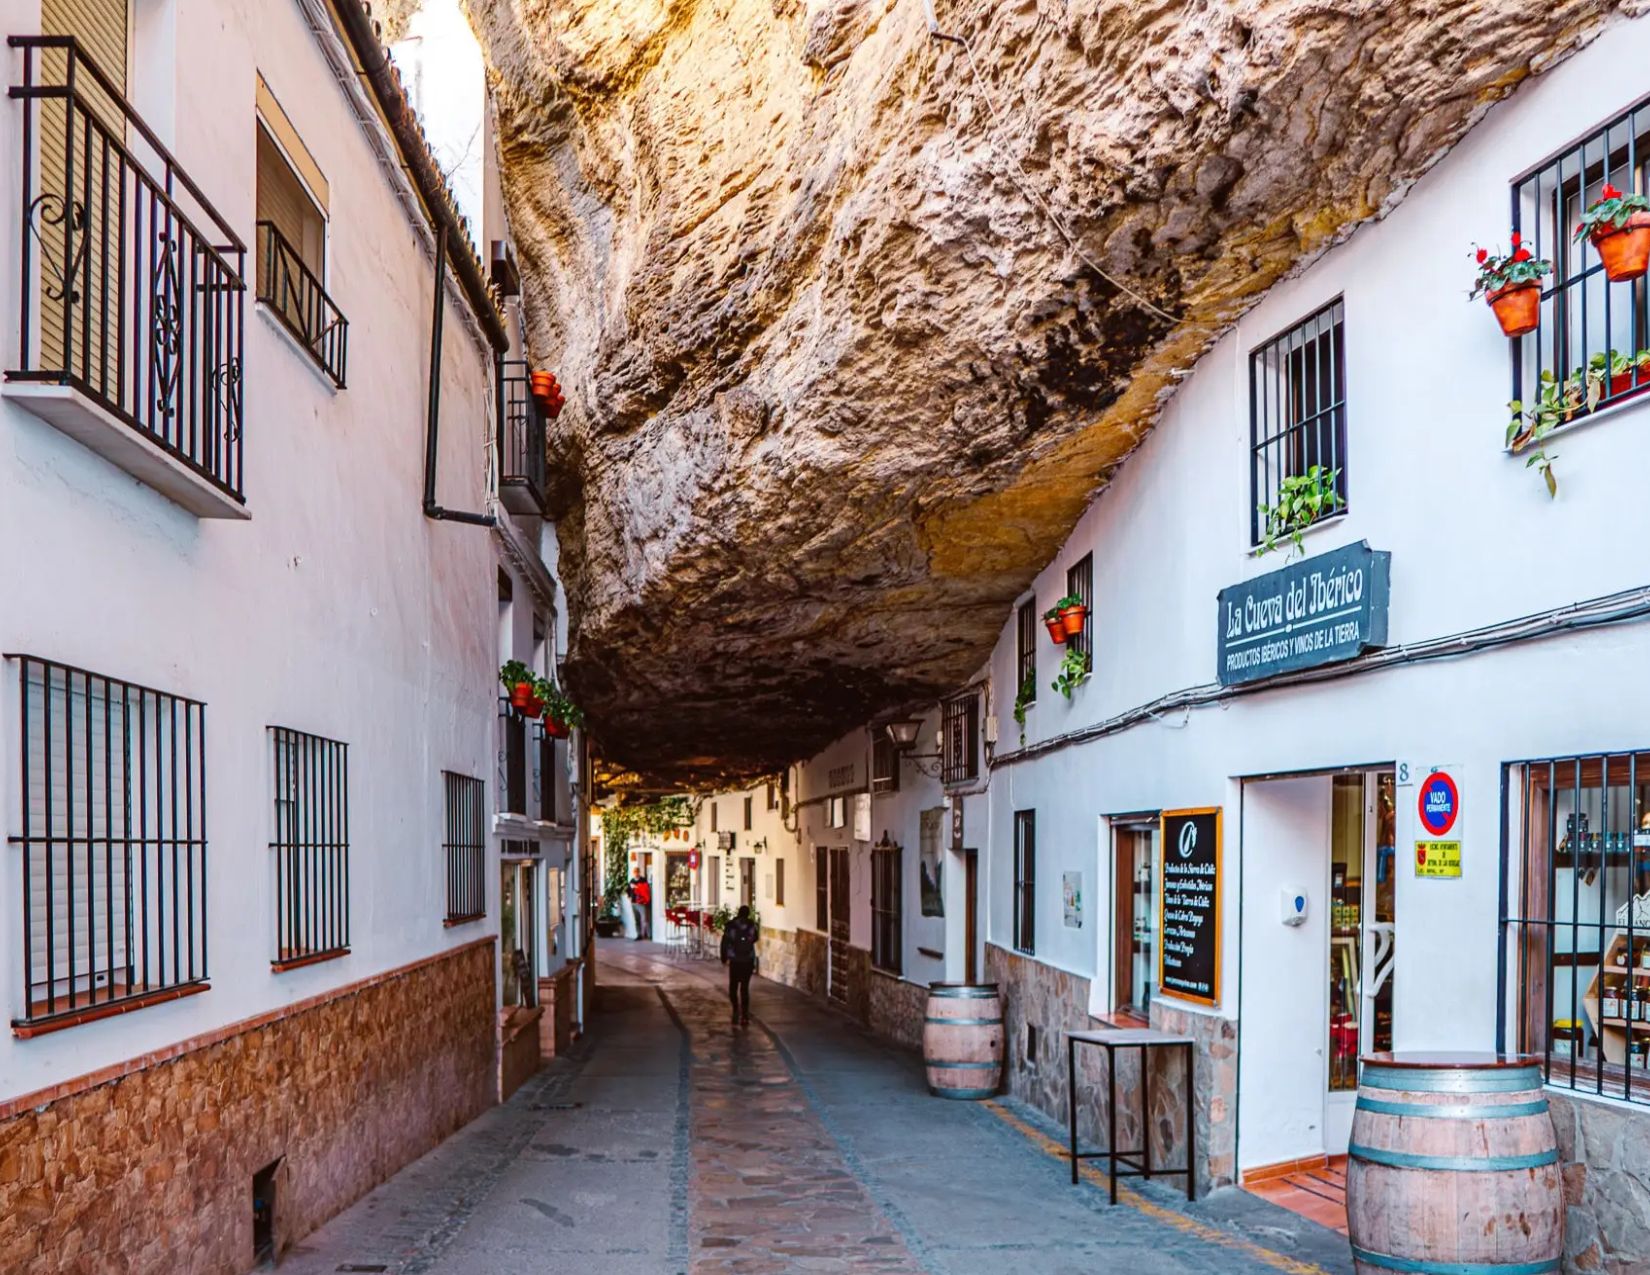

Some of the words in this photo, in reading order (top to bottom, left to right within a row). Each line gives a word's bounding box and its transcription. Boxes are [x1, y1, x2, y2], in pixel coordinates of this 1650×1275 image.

[1226, 602, 1242, 639] La
[1244, 594, 1282, 633] Cueva
[1286, 577, 1306, 620] del
[1309, 566, 1363, 614] Ibérico
[1226, 650, 1261, 671] PRODUCTOS
[1261, 639, 1289, 664] IBÉRICOS
[1289, 639, 1294, 656] Y
[1295, 636, 1313, 655] VINOS
[1314, 633, 1324, 650] DE
[1324, 629, 1334, 647] LA
[1334, 621, 1360, 646] TIERRA
[1400, 763, 1409, 782] 8
[1430, 791, 1446, 804] VADO
